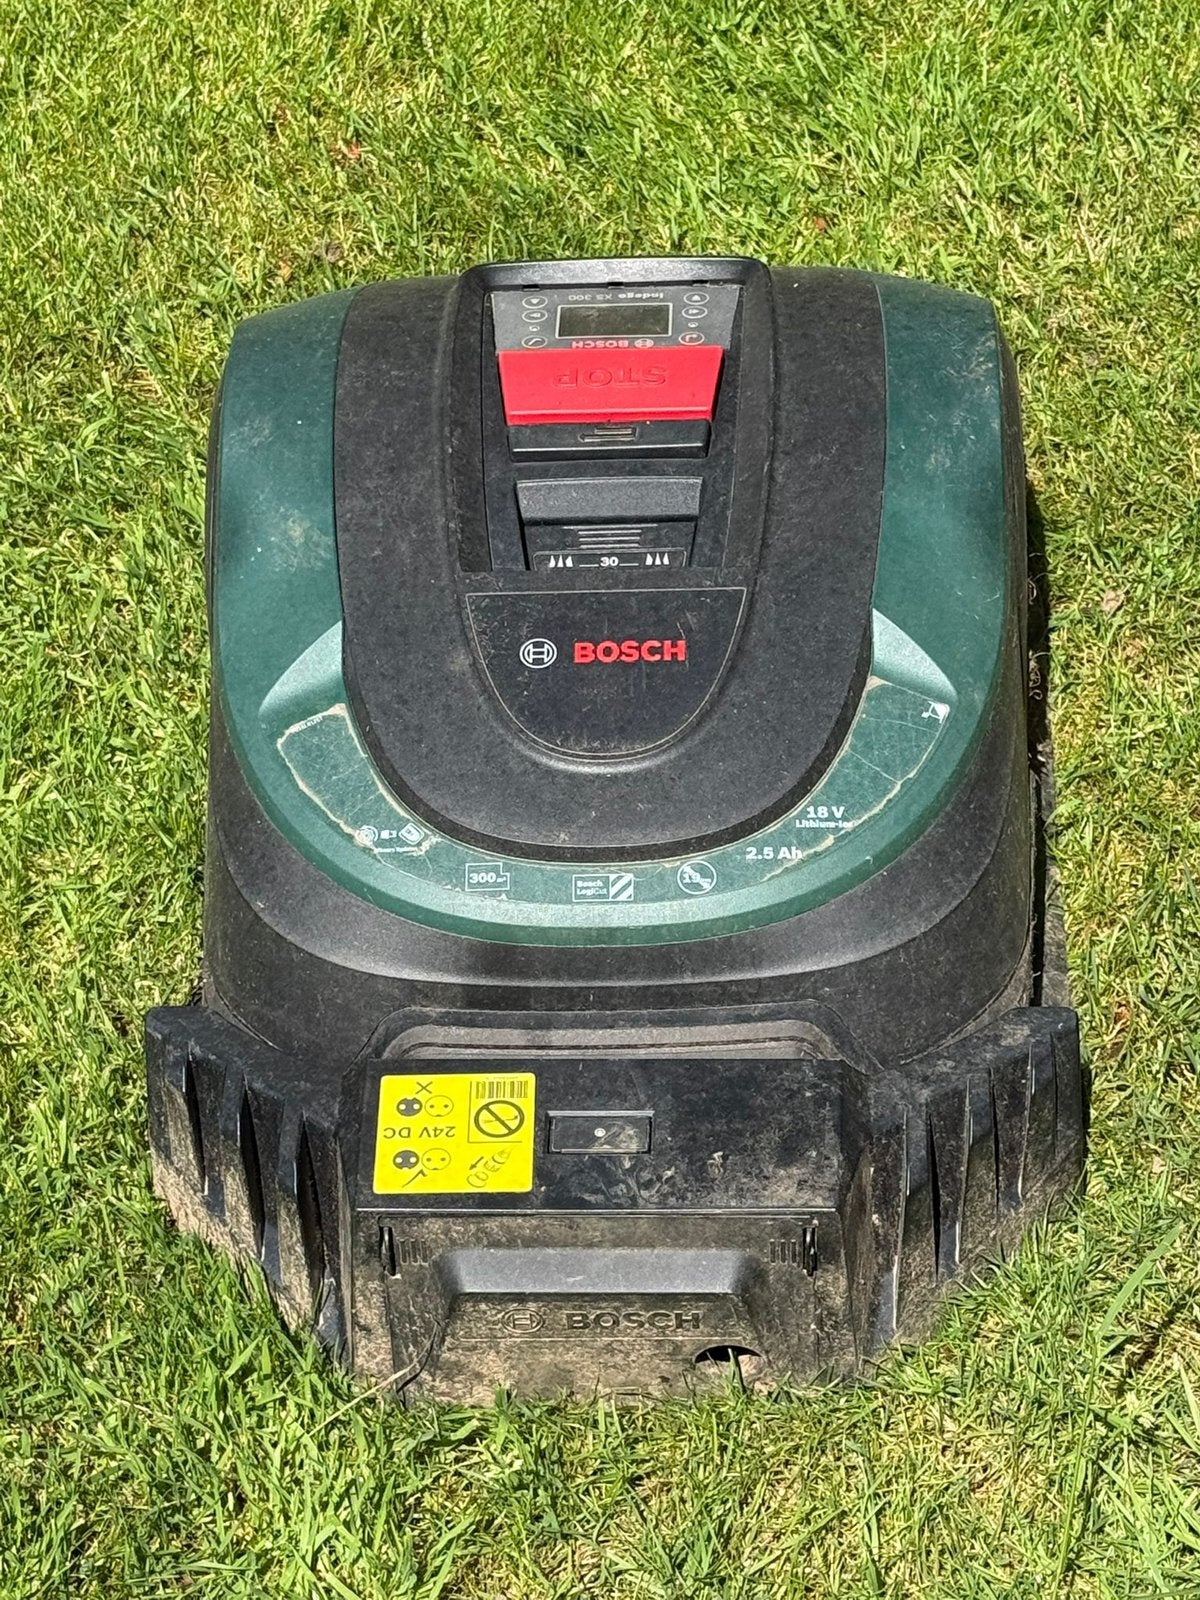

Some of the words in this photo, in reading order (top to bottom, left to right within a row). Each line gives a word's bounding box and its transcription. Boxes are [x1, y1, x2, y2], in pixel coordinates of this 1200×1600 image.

[568, 294, 593, 302] 300
[617, 292, 664, 300] Indego
[571, 340, 629, 350] BOSCH
[552, 365, 667, 388] STOP
[600, 555, 619, 567] 30
[573, 639, 687, 664] BOSCH
[806, 805, 829, 819] 18
[831, 805, 846, 819] V
[745, 846, 774, 860] 2.5
[776, 846, 803, 860] Ah
[576, 880, 603, 888] Bosch
[576, 887, 608, 896] LogiCut
[383, 1126, 412, 1139] DC
[418, 1126, 456, 1139] 24V
[565, 1310, 701, 1330] BOSCH
